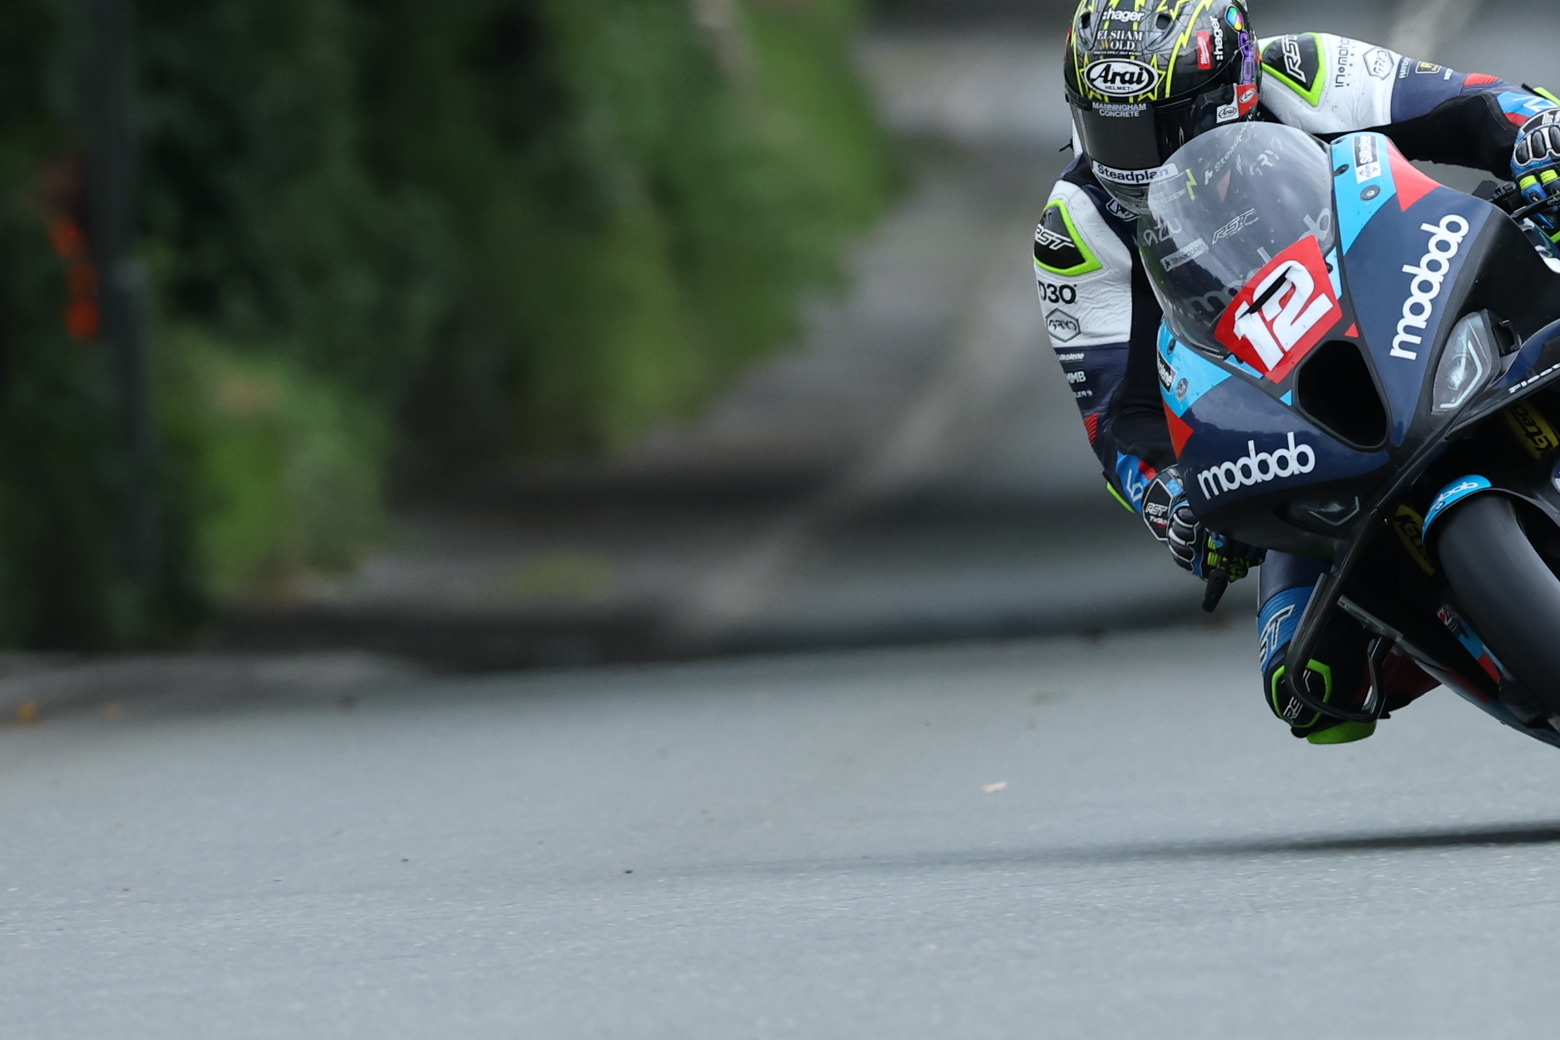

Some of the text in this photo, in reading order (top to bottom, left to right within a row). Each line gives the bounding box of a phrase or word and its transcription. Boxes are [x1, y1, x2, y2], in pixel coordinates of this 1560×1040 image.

[1097, 30, 1143, 41] ELSHAM
[1089, 63, 1146, 86] Arai
[1092, 102, 1147, 111] MANNINGHAM
[1098, 109, 1140, 118] CONCRETE
[1097, 164, 1169, 184] Steadplan
[1232, 259, 1335, 372] 12
